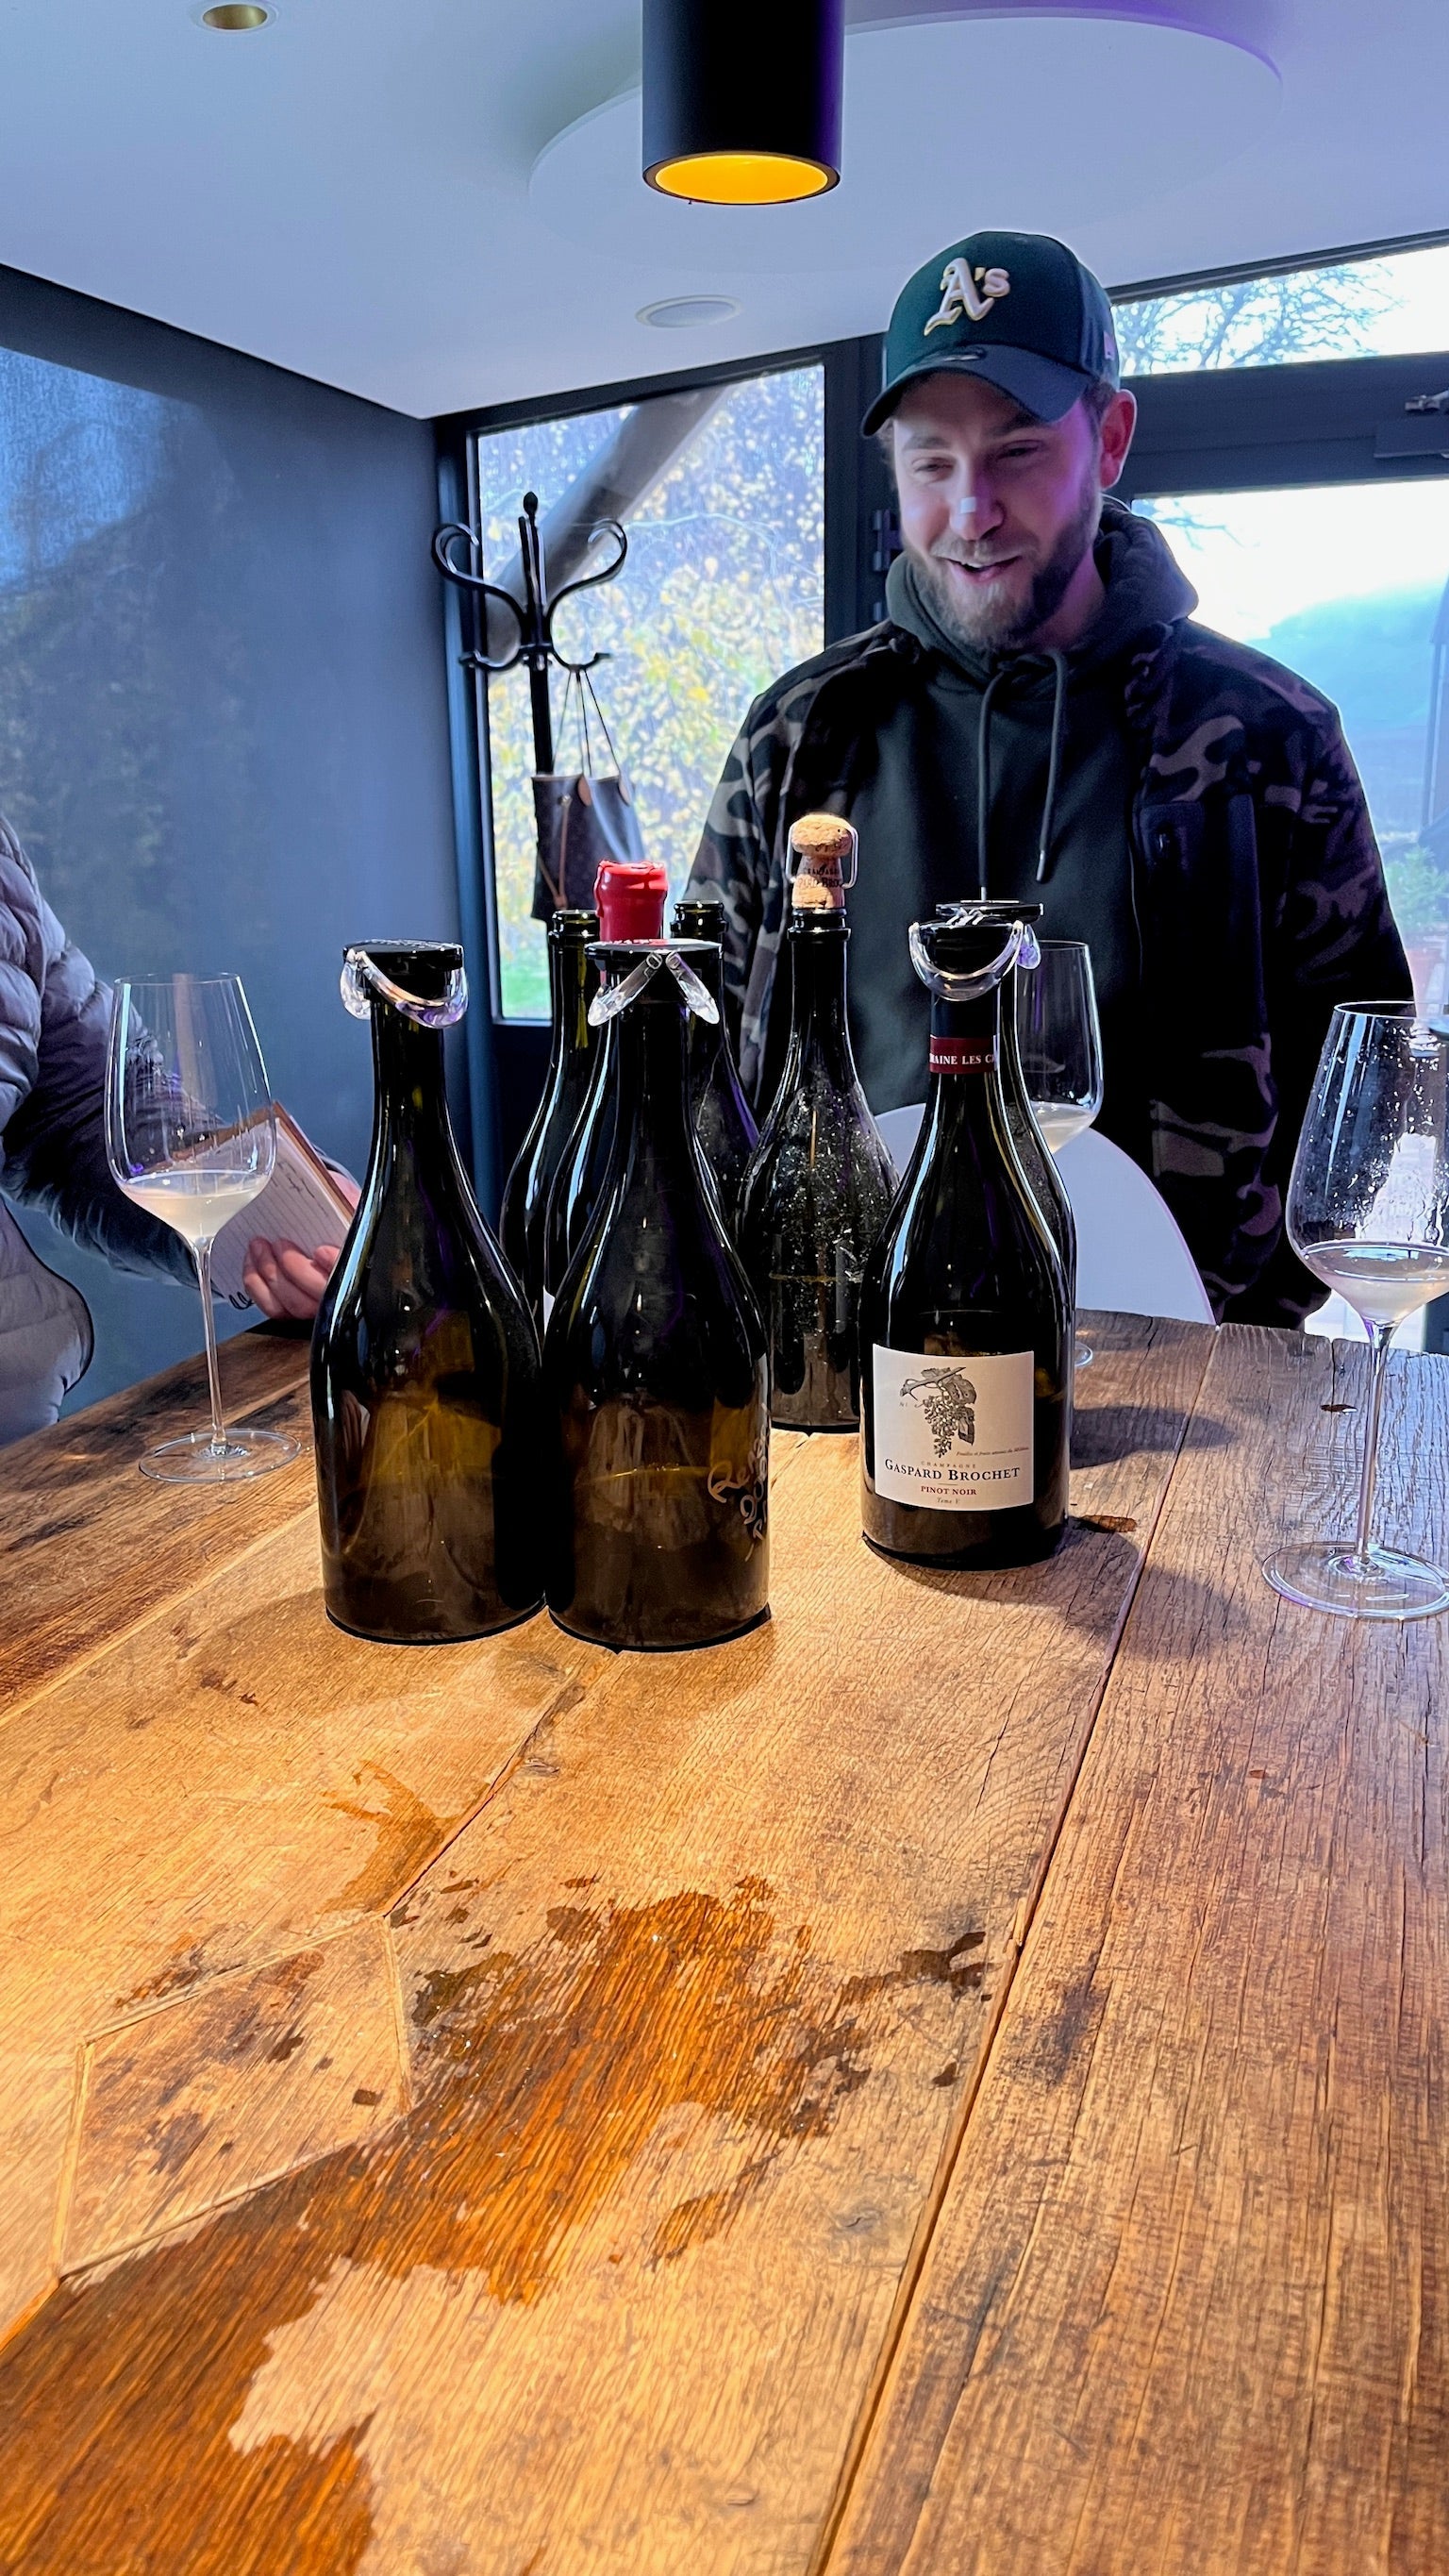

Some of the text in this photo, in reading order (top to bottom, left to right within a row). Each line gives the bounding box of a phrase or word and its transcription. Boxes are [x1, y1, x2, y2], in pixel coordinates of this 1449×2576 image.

[923, 257, 1011, 337] A's
[961, 1054, 982, 1065] LES
[921, 1460, 976, 1469] CHAMPAGNE
[921, 1485, 950, 1495] PINOT
